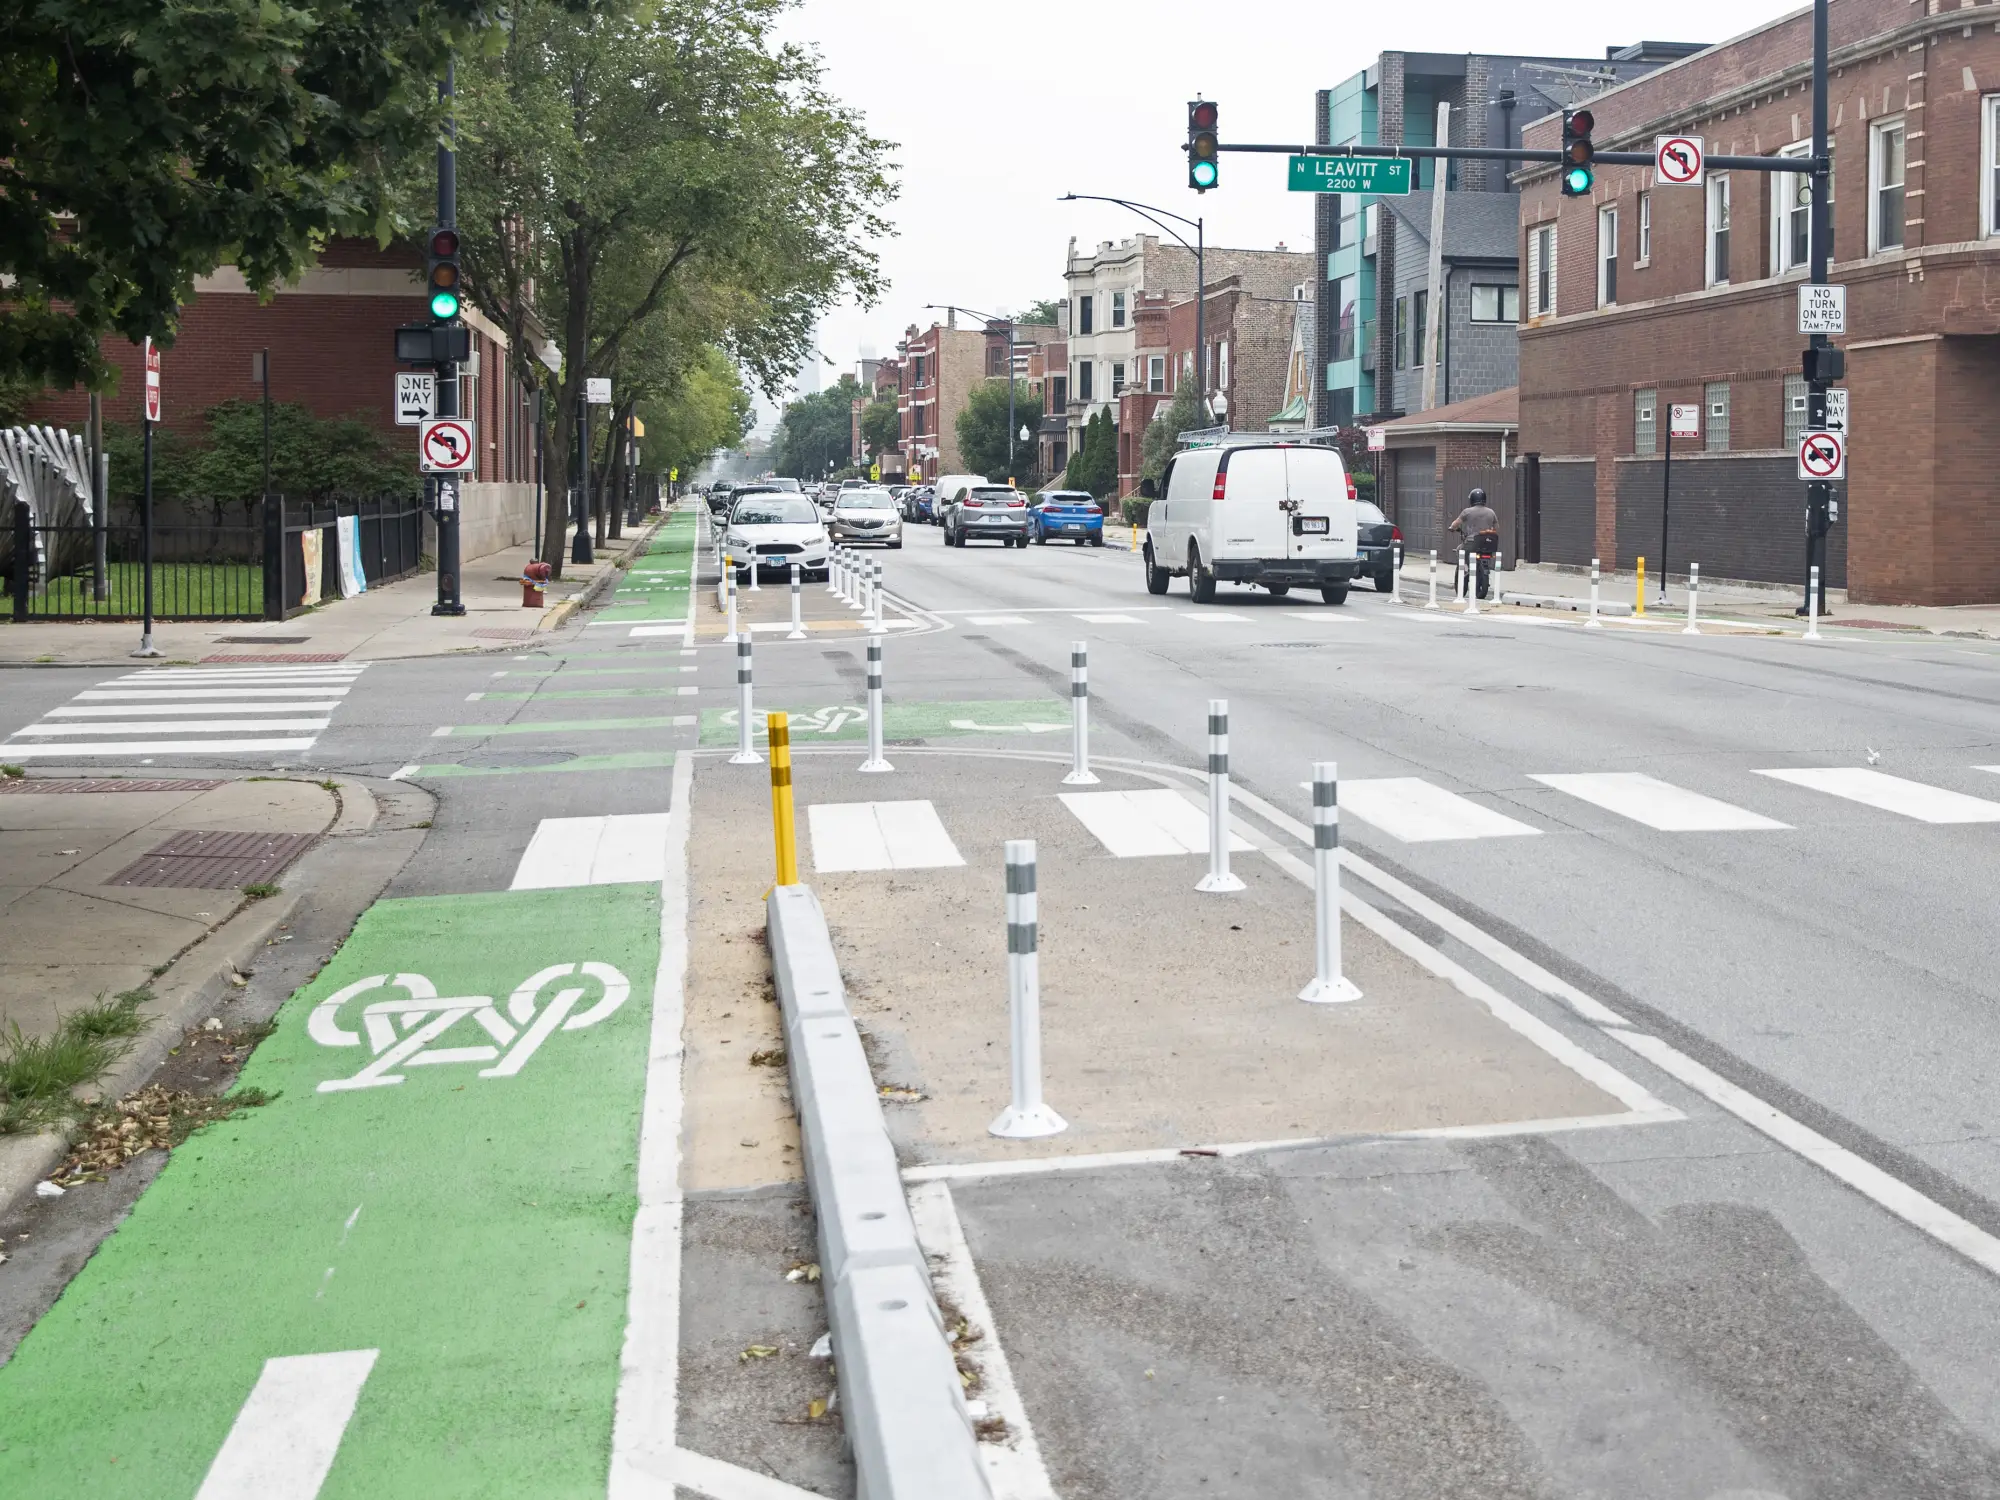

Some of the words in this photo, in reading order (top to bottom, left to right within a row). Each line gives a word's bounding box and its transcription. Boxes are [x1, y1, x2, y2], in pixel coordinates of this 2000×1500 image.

[1297, 162, 1305, 173] N
[1315, 161, 1378, 177] LEAVITT
[1388, 165, 1402, 176] ST
[1326, 178, 1356, 189] 2200
[1362, 179, 1372, 190] W
[1813, 289, 1831, 298] NO
[1809, 299, 1836, 309] TURN
[1802, 310, 1819, 319] ON
[1821, 310, 1842, 319] RED
[1802, 320, 1842, 330] 7AM-7PM
[401, 377, 431, 390] ONE
[400, 391, 431, 404] WAY
[1826, 392, 1845, 404] ONE
[1825, 406, 1845, 418] WAY
